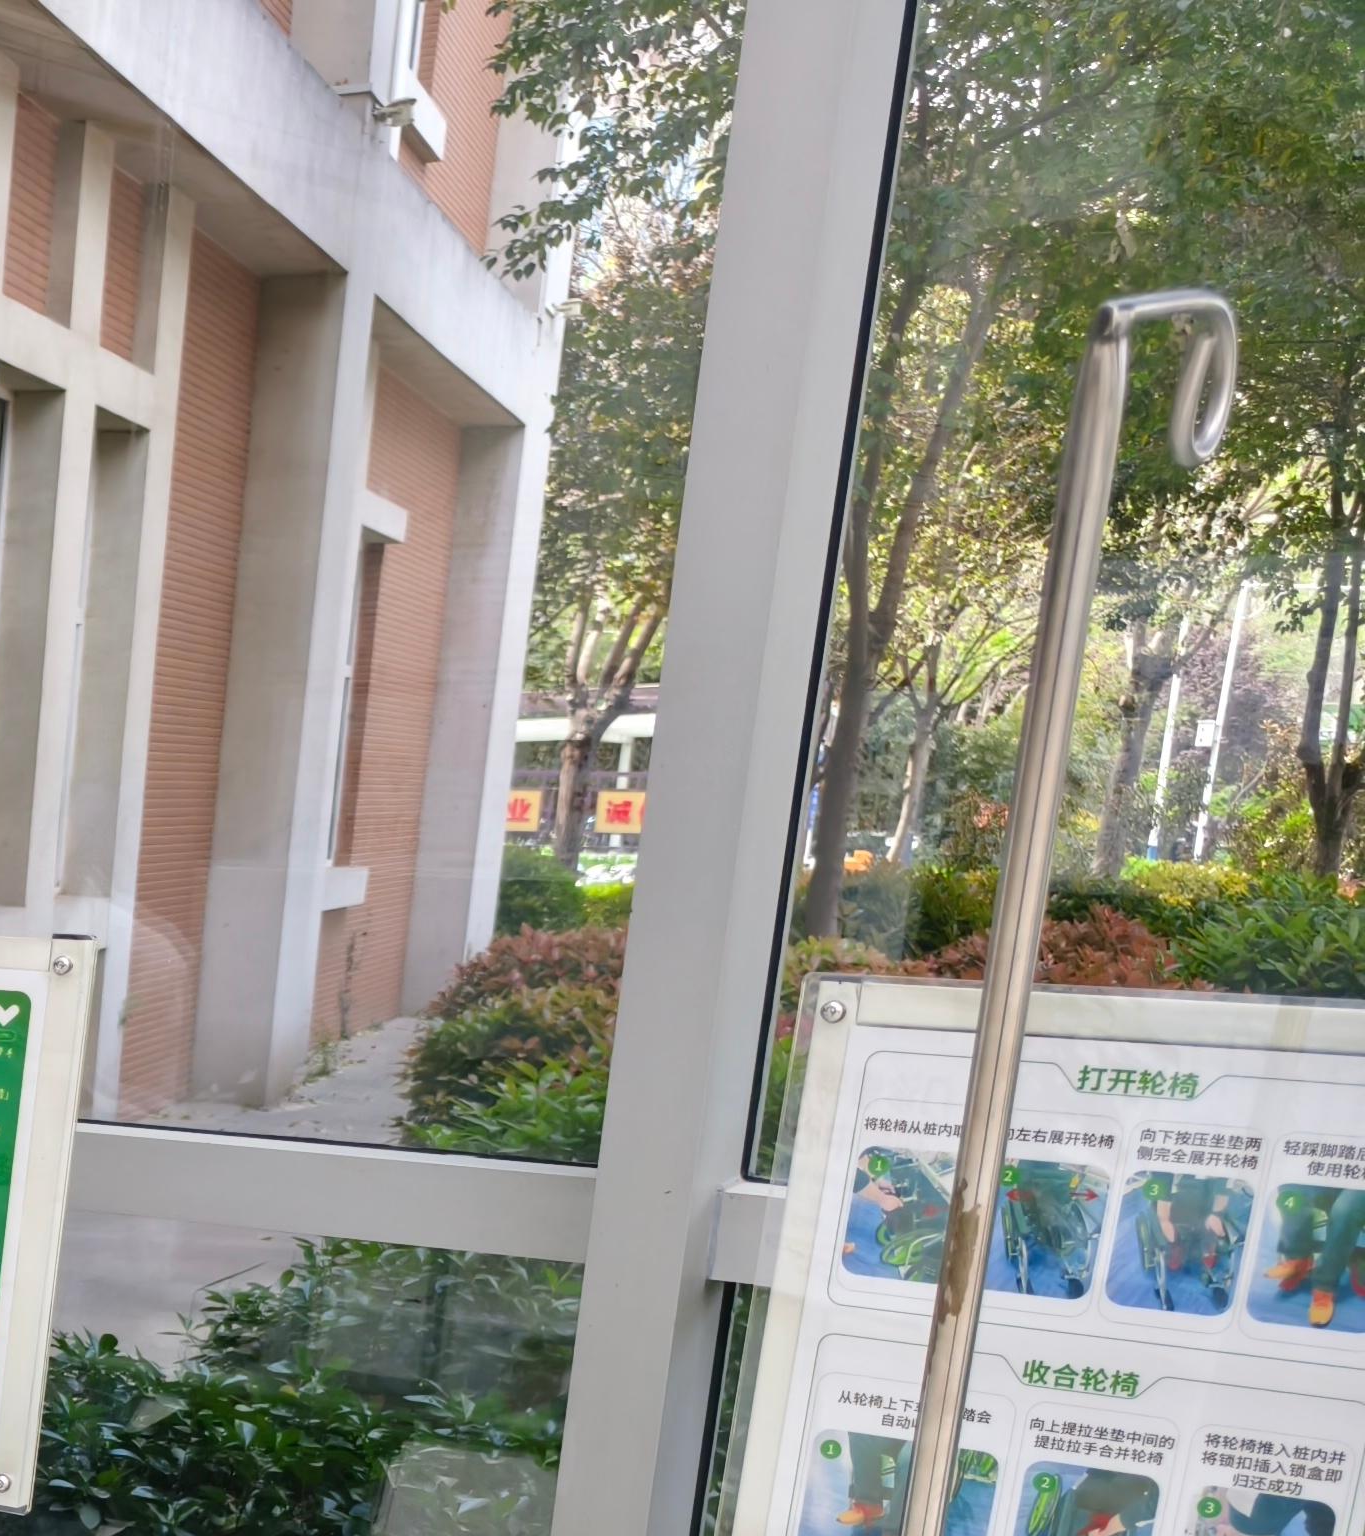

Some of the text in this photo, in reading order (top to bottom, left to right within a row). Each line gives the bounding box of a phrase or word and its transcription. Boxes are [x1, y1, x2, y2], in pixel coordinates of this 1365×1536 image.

[1077, 1064, 1200, 1099] 打开轮椅
[1140, 1129, 1262, 1151] 向下按压坐垫两
[1137, 1149, 1258, 1170] 侧完全展开轮椅
[1307, 1160, 1365, 1180] 使用轮
[1023, 1360, 1140, 1397] 收合轮椅
[1029, 1418, 1174, 1449] 向上提拉坐垫中间的
[1034, 1435, 1163, 1465] 提拉拉手合并轮椅
[1205, 1433, 1346, 1465] 将轮椅推入桩内并
[1201, 1451, 1343, 1483] 将锁扣插入锁盒即
[1233, 1474, 1302, 1496] 归还成功
